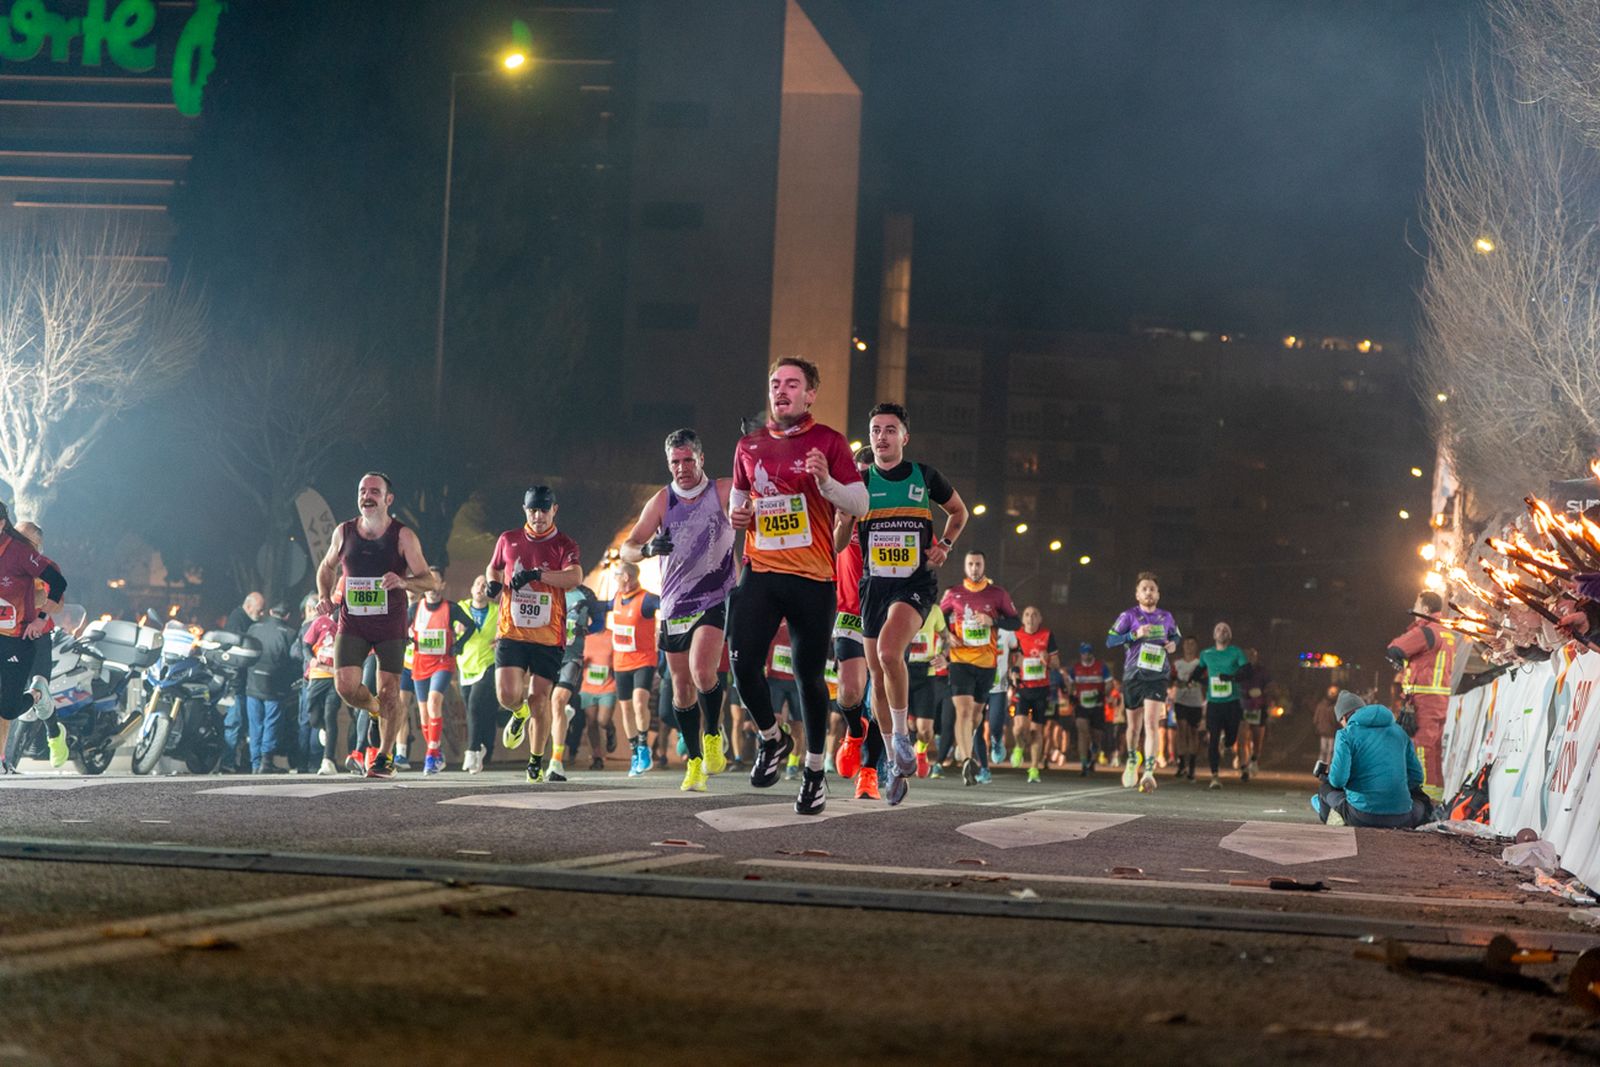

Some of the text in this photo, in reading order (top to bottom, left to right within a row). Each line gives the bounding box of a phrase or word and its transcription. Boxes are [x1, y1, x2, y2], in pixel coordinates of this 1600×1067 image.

[764, 513, 800, 532] 2455
[871, 521, 924, 530] CERDANYOLA
[879, 548, 910, 562] 5198
[353, 591, 379, 603] 7867
[520, 603, 541, 616] 930
